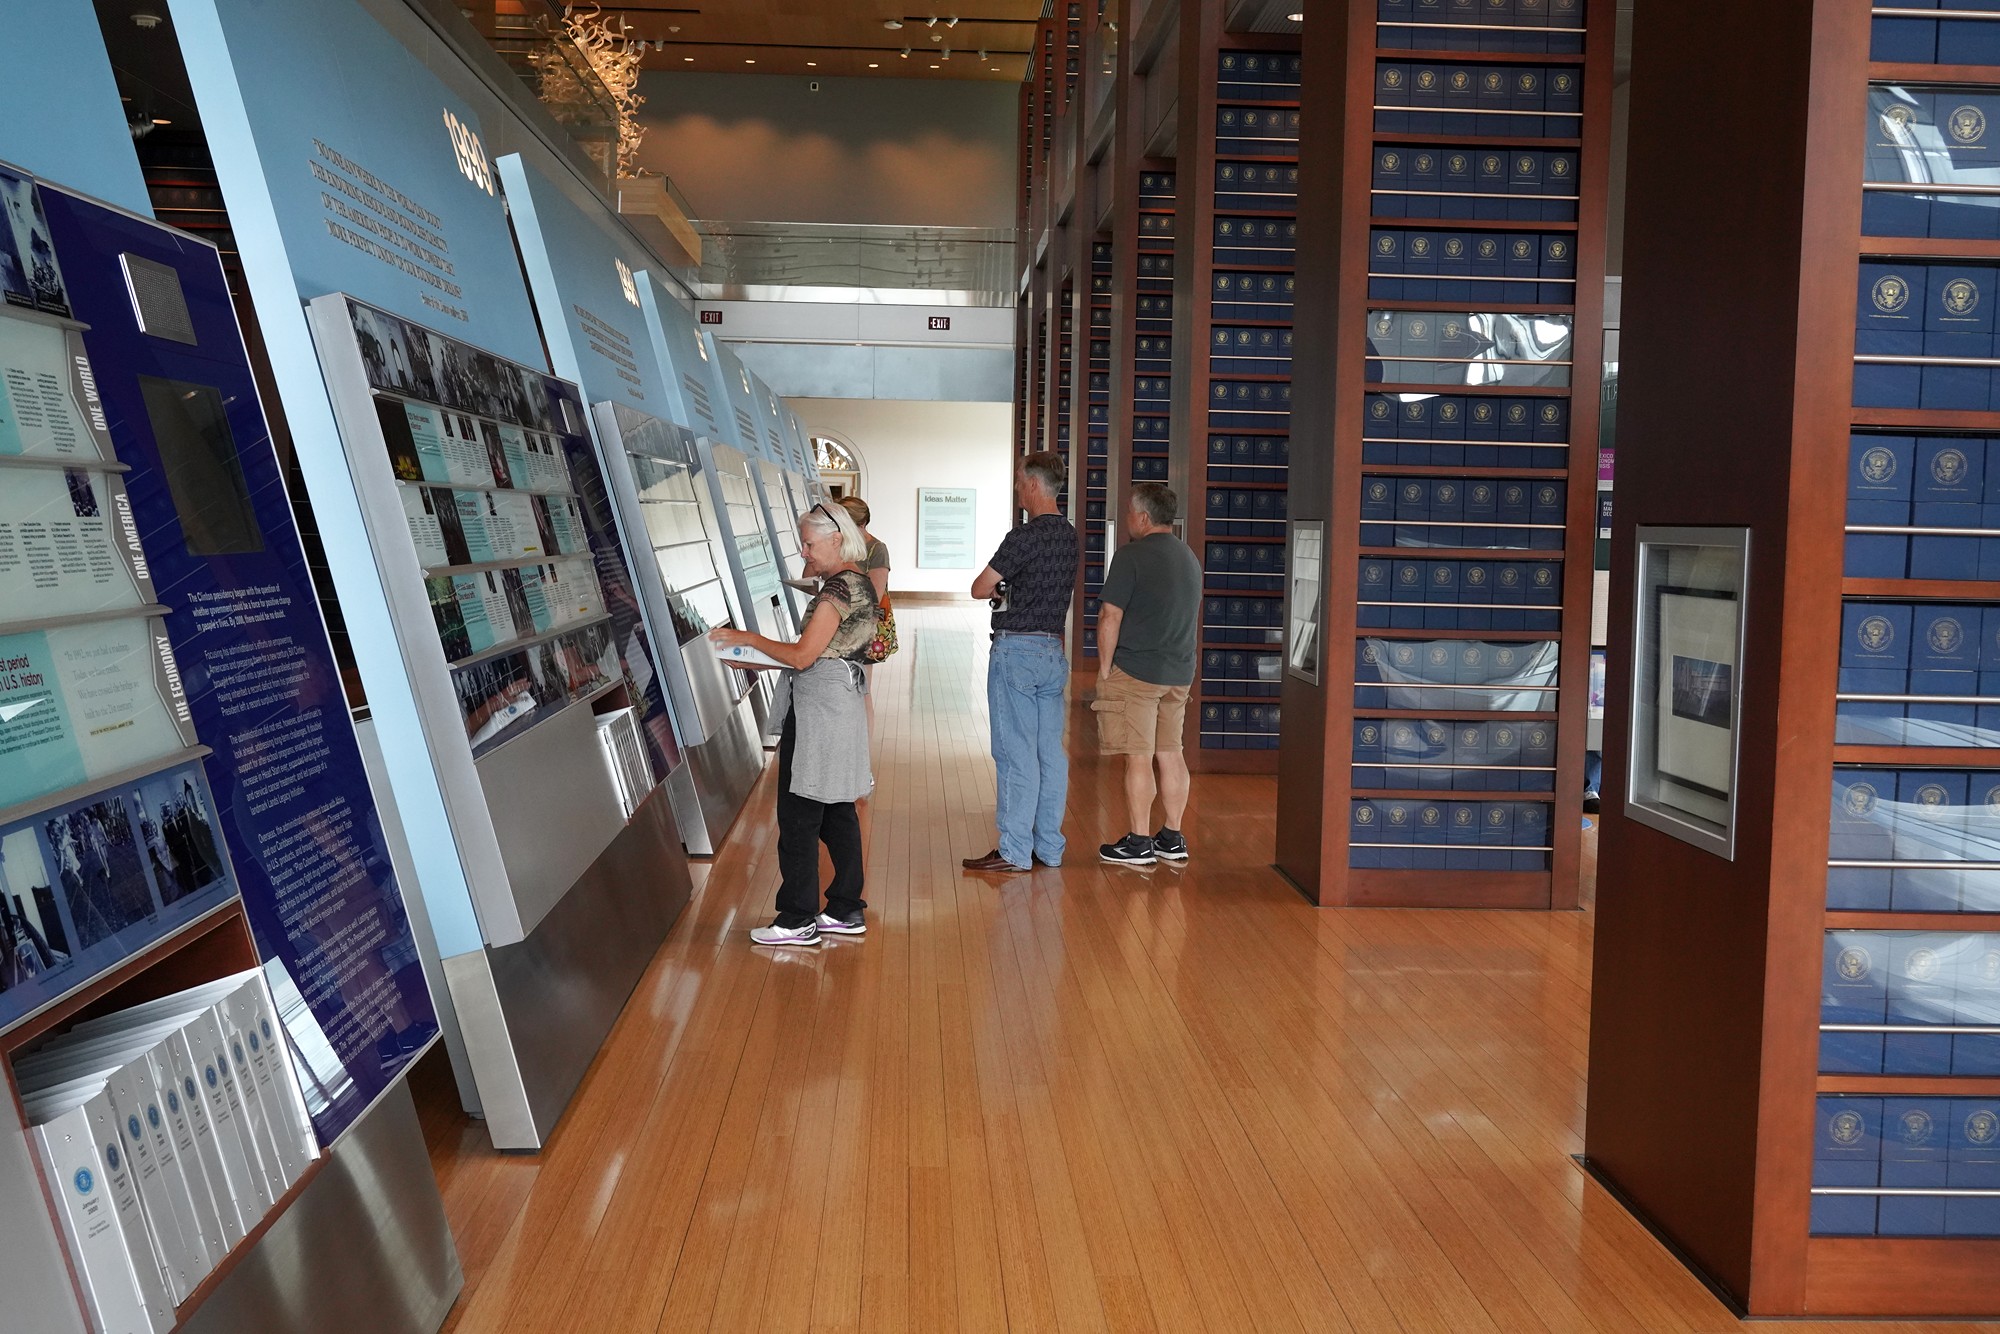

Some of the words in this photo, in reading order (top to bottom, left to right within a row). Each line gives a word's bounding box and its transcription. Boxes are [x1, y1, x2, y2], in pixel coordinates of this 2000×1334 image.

[443, 107, 493, 197] 1999
[705, 313, 719, 323] EXIT
[932, 318, 947, 329] EXIT
[75, 355, 99, 402] WORLD
[89, 405, 107, 431] ONE
[115, 493, 142, 552] AMERICA
[132, 554, 149, 580] ONE
[8, 655, 30, 672] period
[156, 636, 184, 698] ECONOMY
[5, 675, 21, 690] U.S.
[21, 672, 44, 687] history
[175, 700, 191, 724] THE
[82, 1197, 99, 1210] January
[88, 1205, 99, 1215] 2000
